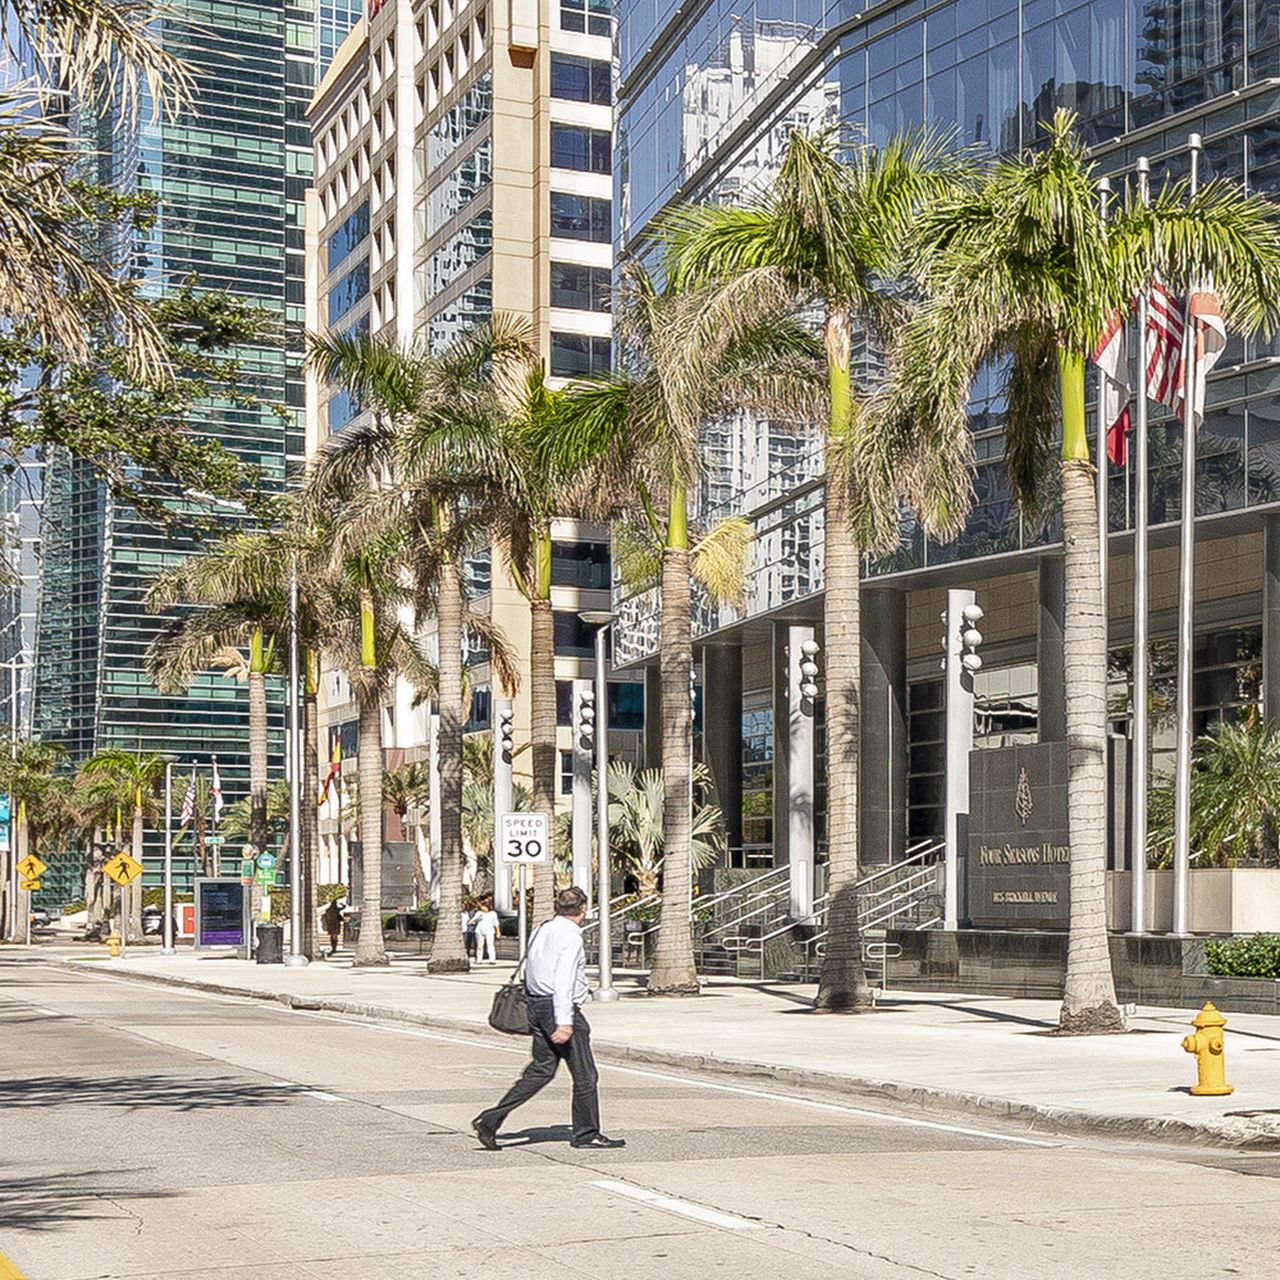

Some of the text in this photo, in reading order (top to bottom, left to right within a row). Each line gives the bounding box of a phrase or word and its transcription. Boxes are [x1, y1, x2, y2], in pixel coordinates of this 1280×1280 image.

[505, 818, 543, 828] SPEED
[509, 829, 538, 838] LIMIT
[507, 839, 542, 858] 30
